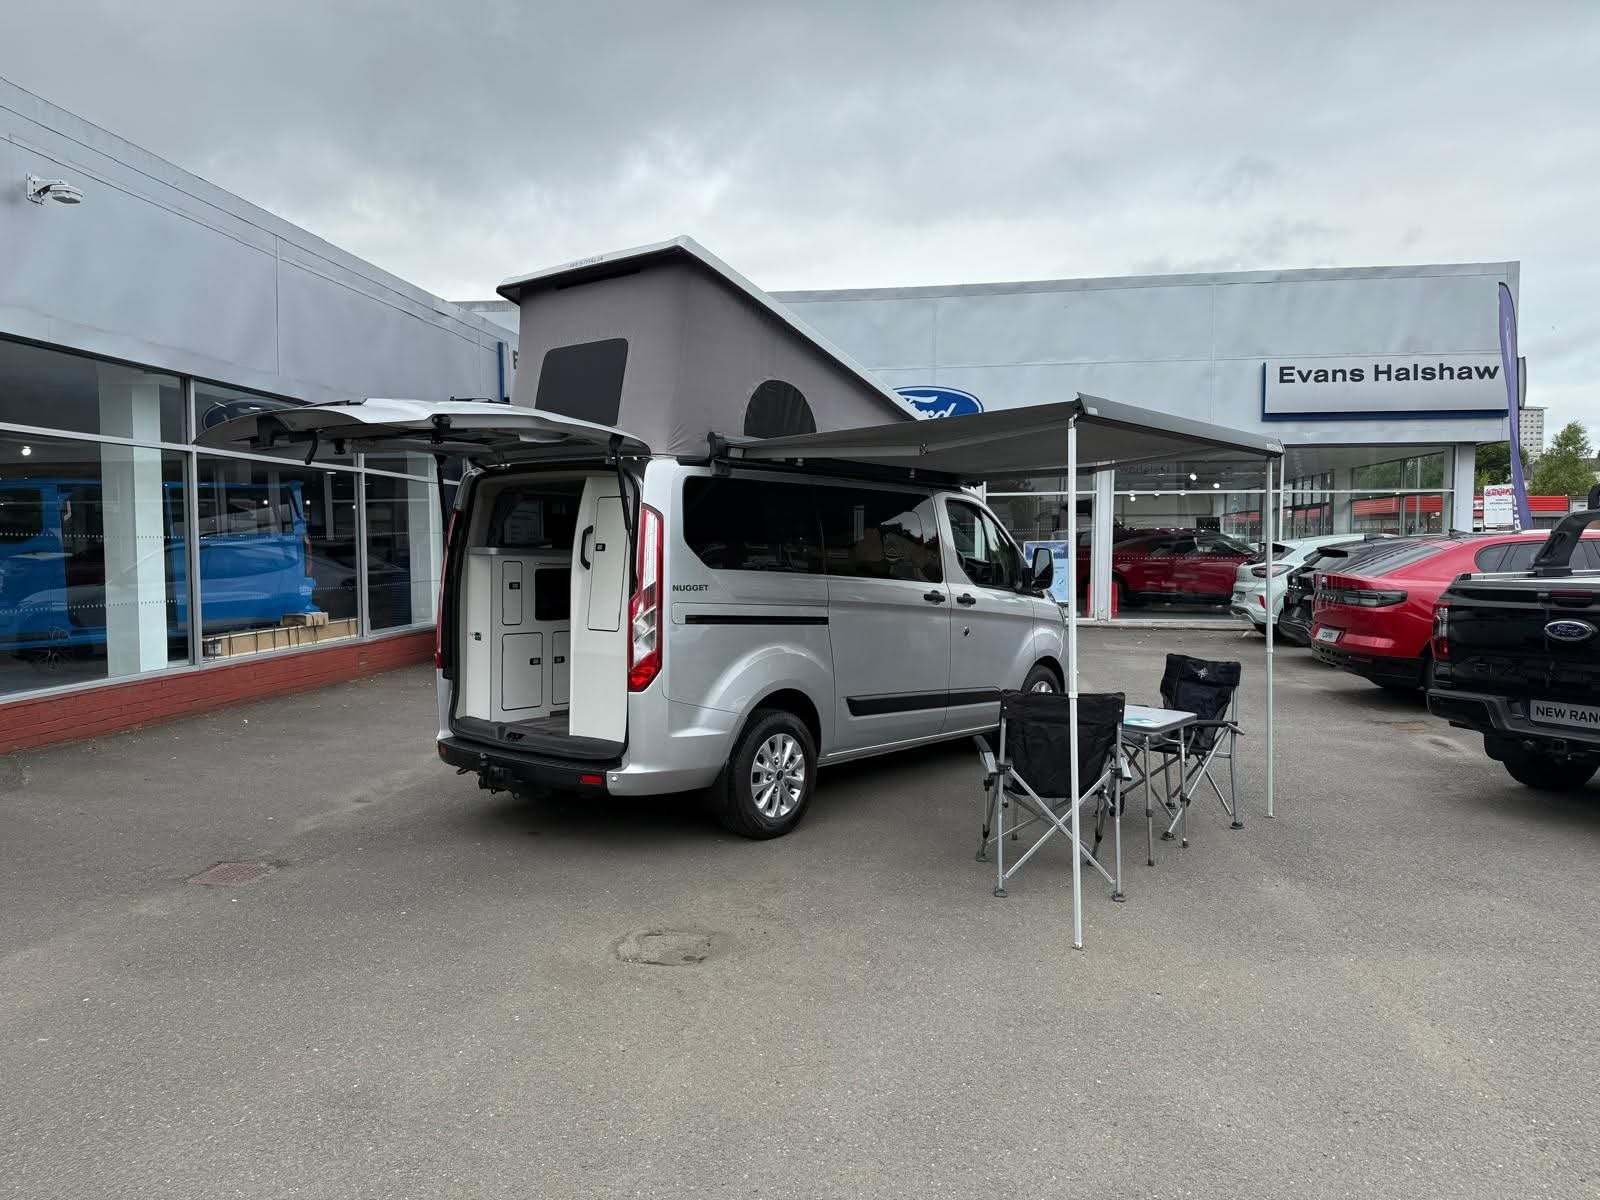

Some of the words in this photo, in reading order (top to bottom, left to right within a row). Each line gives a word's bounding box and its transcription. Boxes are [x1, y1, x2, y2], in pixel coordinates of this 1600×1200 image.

[1279, 366, 1365, 384] Evans
[1374, 363, 1499, 382] Halshaw
[672, 584, 709, 592] NUGGET
[1536, 706, 1566, 719] NEW
[1569, 709, 1600, 724] RAN
